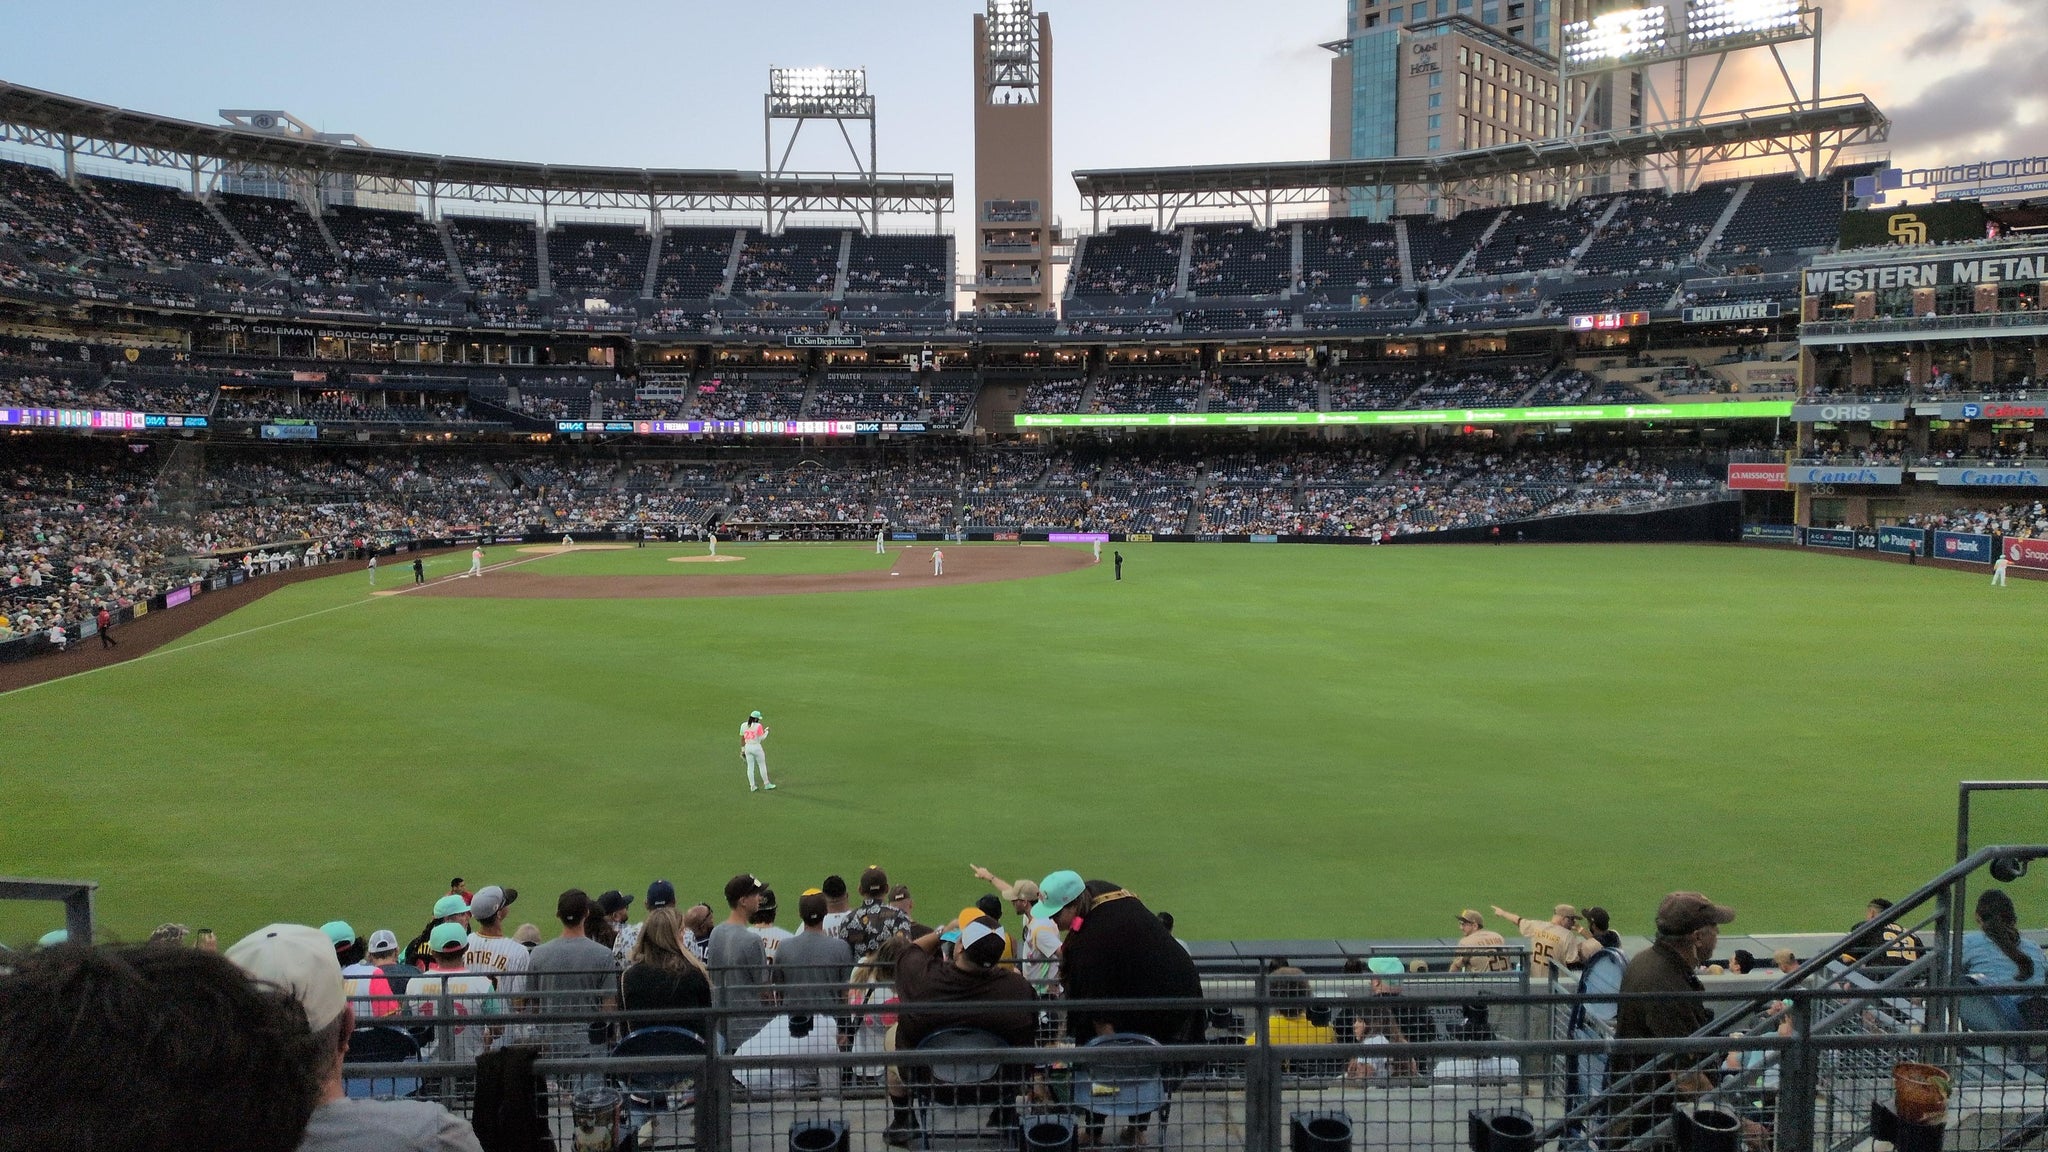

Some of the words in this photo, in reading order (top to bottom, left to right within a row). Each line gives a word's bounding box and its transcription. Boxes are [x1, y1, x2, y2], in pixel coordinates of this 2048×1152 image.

[1910, 156, 2048, 190] QuidelOrth
[1938, 189, 1970, 199] OFFICIAL
[1972, 185, 2022, 197] DIAGNOSTICS
[1807, 263, 1938, 293] WESTERN
[1953, 256, 2048, 284] METAL
[255, 308, 283, 316] WINFIELD
[1693, 304, 1768, 321] CUTWATER
[208, 323, 248, 333] JERRY
[253, 325, 313, 336] COLEMAN
[319, 330, 394, 341] BROADCAST
[400, 333, 449, 343] CENTER
[794, 337, 804, 345] UC
[804, 337, 817, 345] San
[817, 337, 835, 347] Diego
[835, 337, 855, 345] Health
[828, 372, 861, 380] CUTWATER
[1821, 405, 1872, 420] ORIS
[1984, 404, 2046, 417] Calimax
[664, 422, 690, 431] FREEMAN
[1809, 469, 1877, 482] Canel's
[1961, 470, 2039, 485] Canel's
[1811, 483, 1835, 495] 336
[1858, 534, 1876, 548] 342
[1957, 539, 1979, 551] bank
[466, 950, 491, 966] ATIS
[1533, 942, 1554, 967] 25
